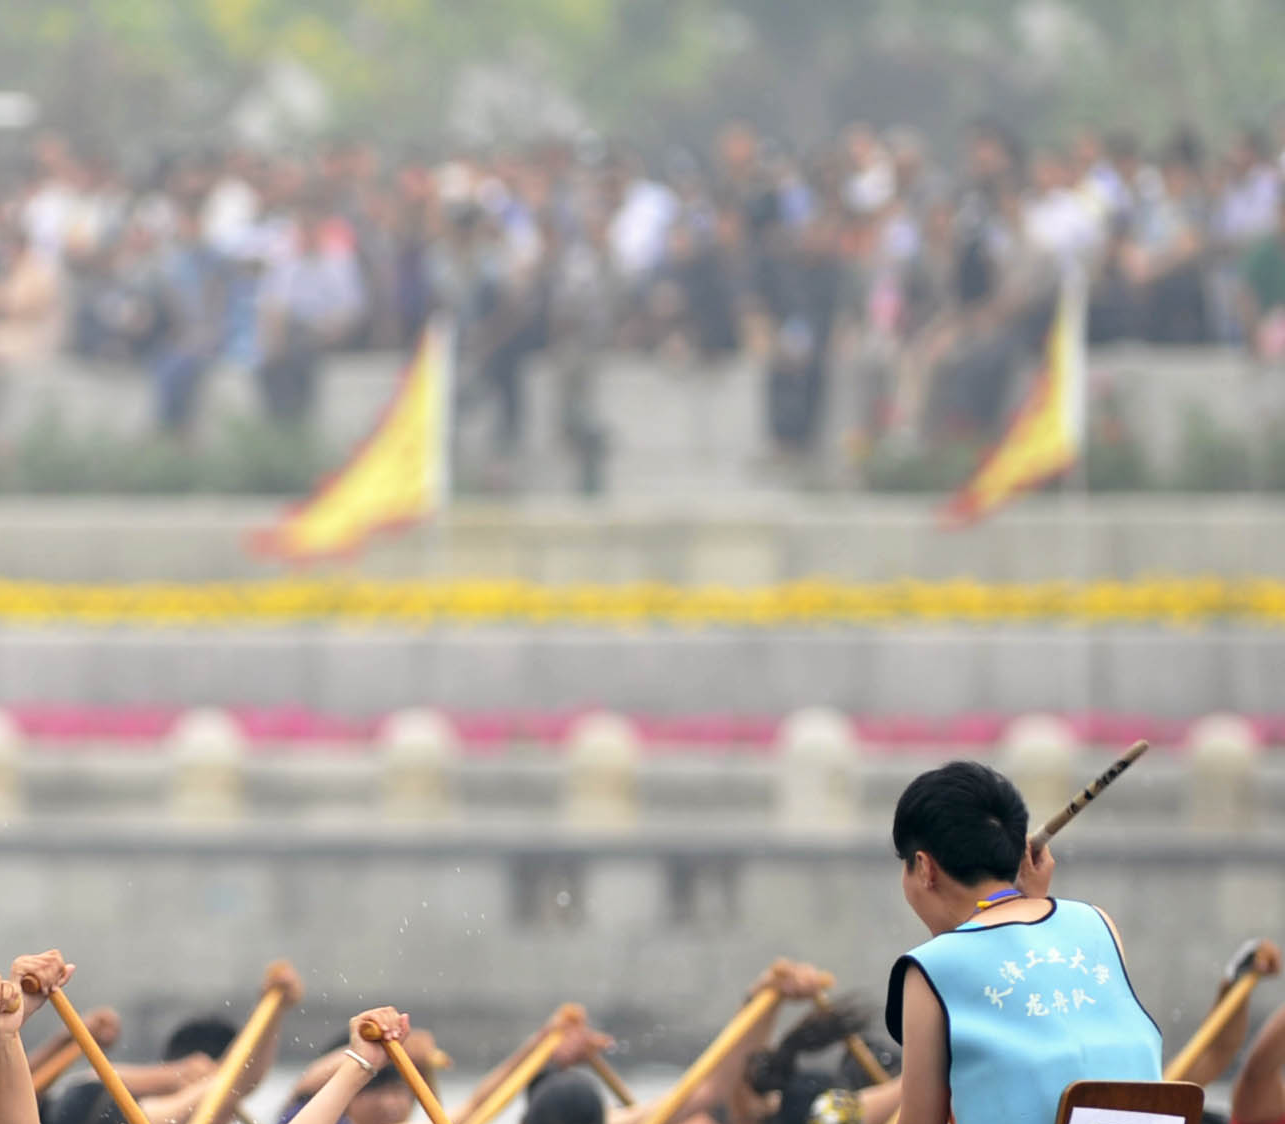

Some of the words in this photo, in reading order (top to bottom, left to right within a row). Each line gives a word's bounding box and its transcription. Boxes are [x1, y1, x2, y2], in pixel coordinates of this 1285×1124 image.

[984, 947, 1110, 1010] 天津工业大学
